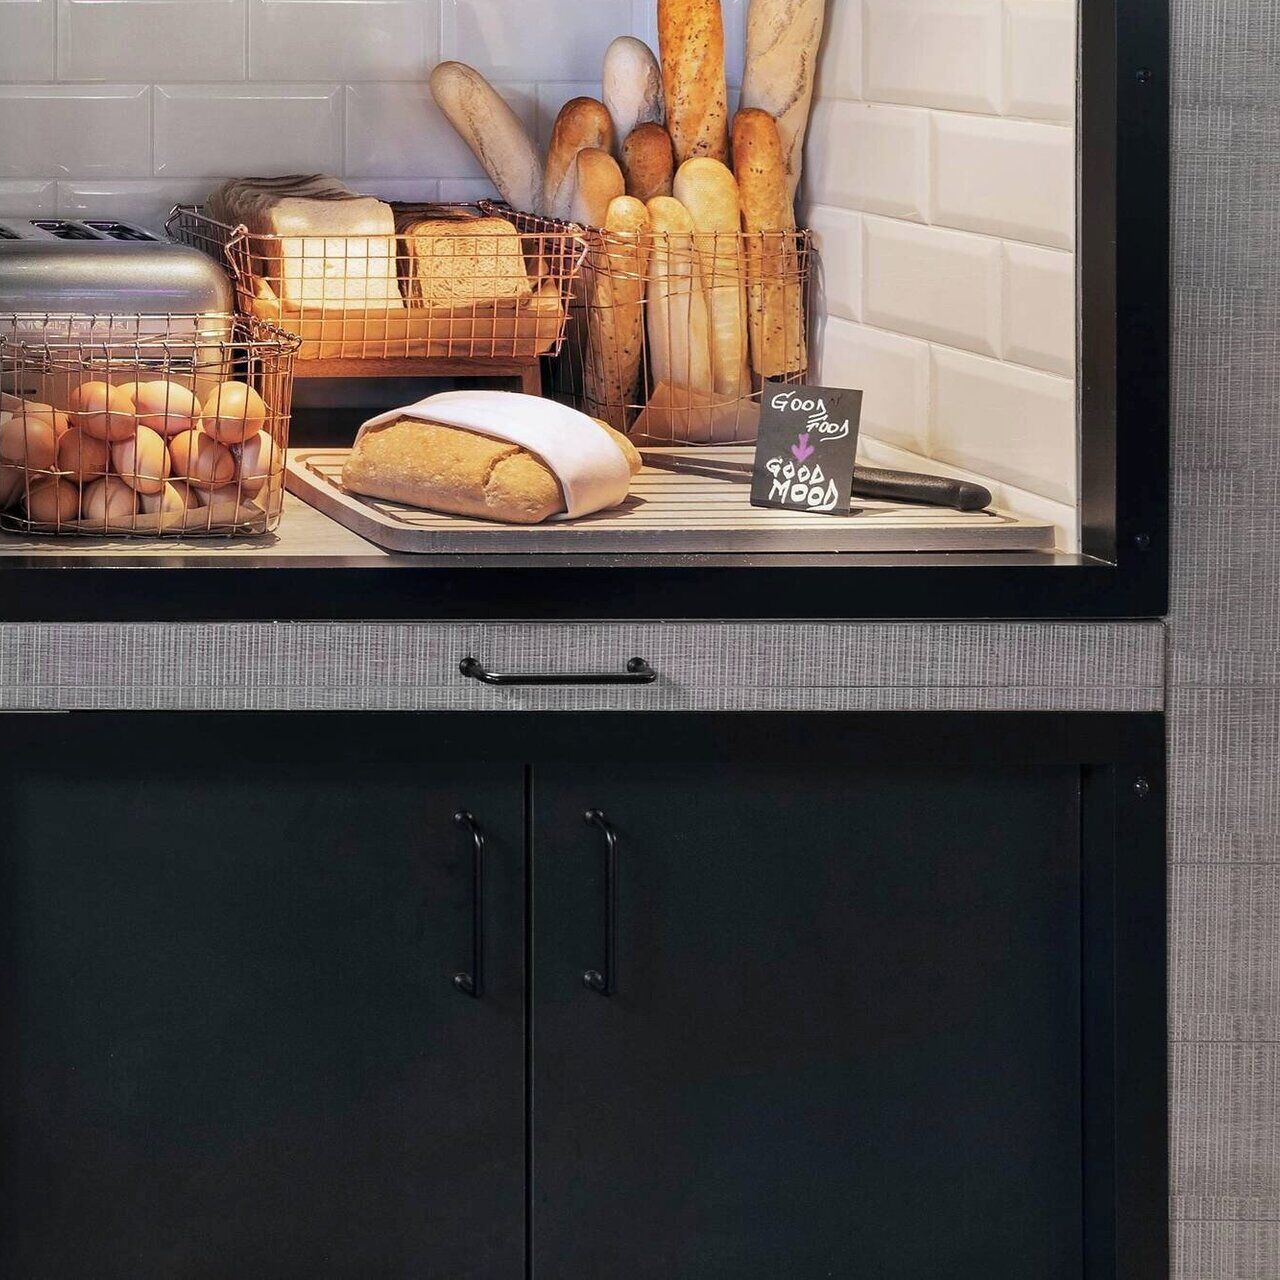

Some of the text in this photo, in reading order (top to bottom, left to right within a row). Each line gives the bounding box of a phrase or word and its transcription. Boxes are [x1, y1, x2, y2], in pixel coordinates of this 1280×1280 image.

[772, 391, 827, 418] GOOD
[806, 414, 849, 442] FOOD
[766, 458, 825, 484] GOOD
[768, 479, 838, 510] MOOD
